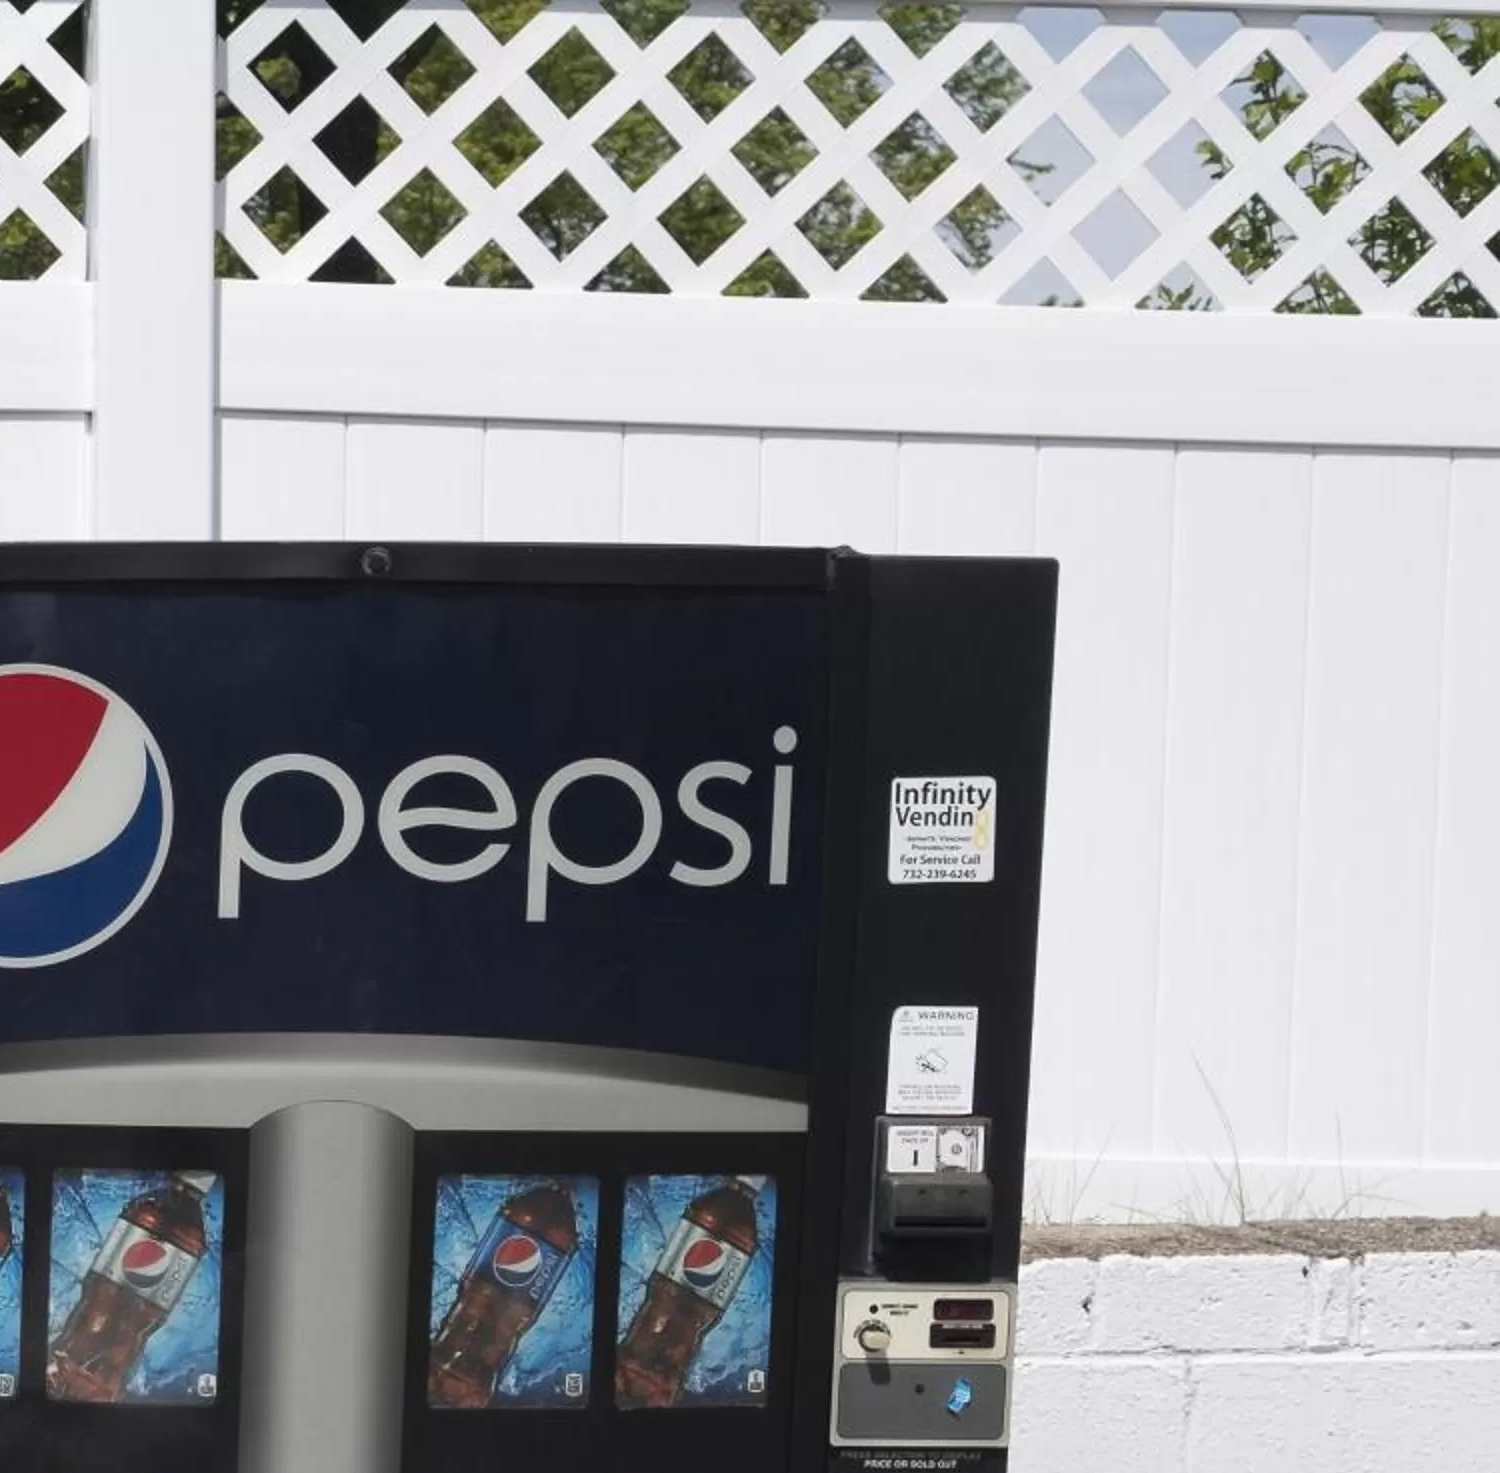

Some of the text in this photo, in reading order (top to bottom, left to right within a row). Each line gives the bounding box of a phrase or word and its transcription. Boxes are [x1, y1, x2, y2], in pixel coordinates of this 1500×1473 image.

[895, 781, 992, 811] Infinity
[218, 724, 798, 922] pepsi
[900, 853, 981, 865] For Service Call
[917, 1011, 974, 1021] WARNING
